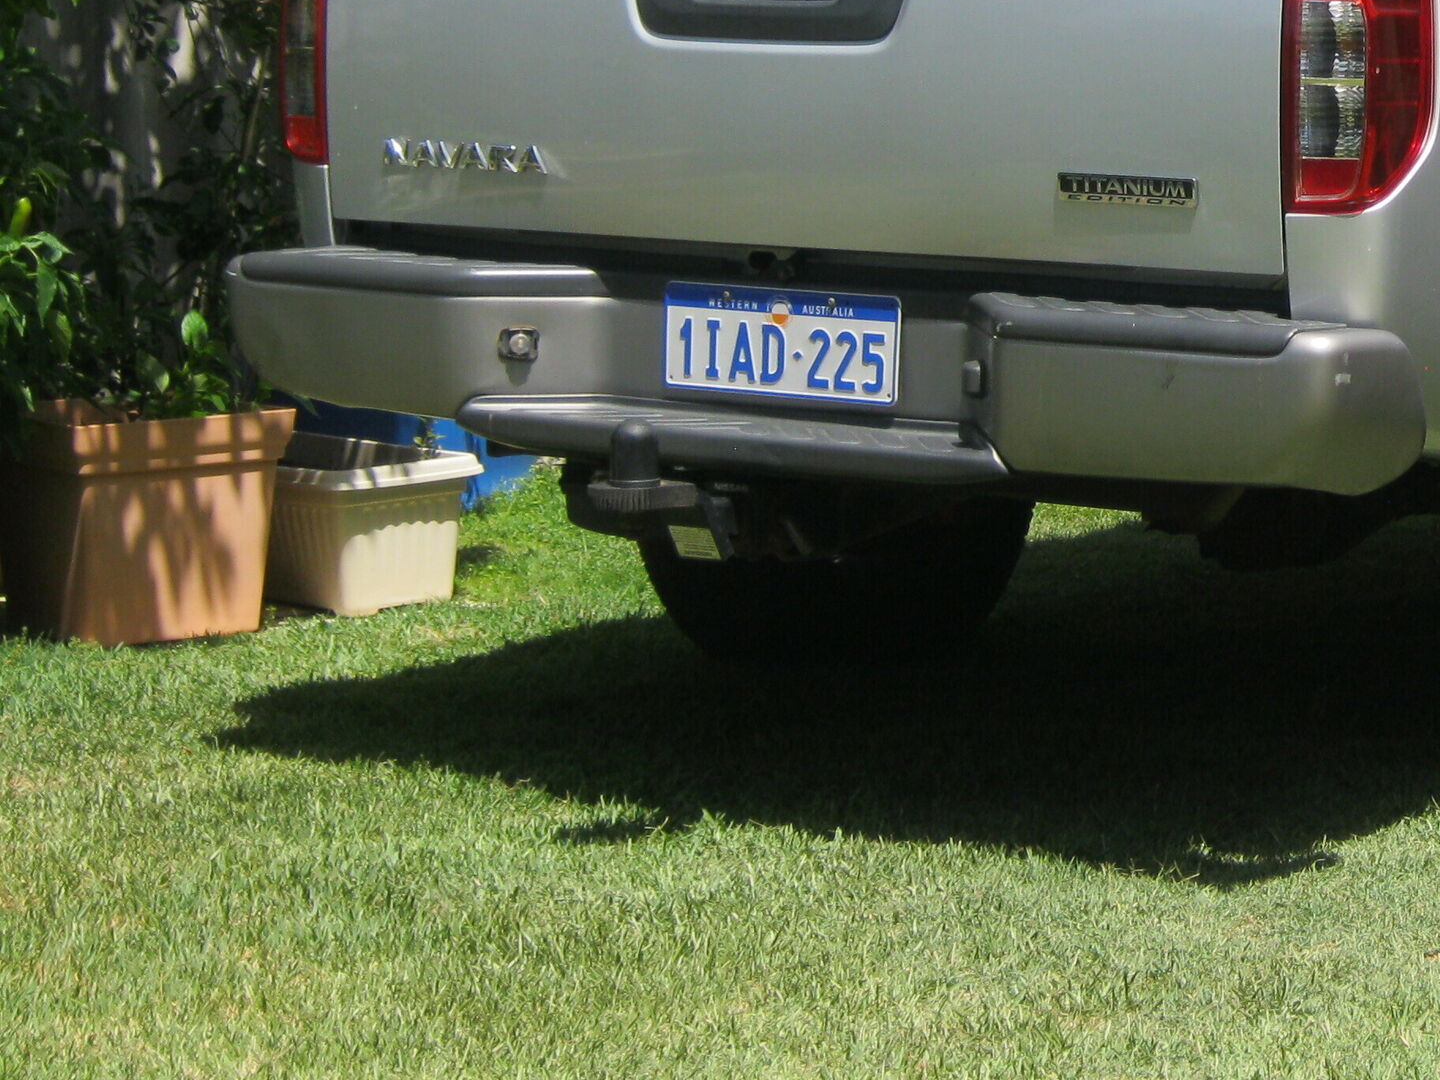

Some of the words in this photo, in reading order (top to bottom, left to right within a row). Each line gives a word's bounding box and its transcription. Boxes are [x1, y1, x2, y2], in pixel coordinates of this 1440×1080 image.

[383, 136, 548, 175] NAVARA
[1066, 175, 1187, 198] TITANIUM
[1068, 194, 1186, 206] EDITION
[801, 304, 855, 318] AUSTRALIA
